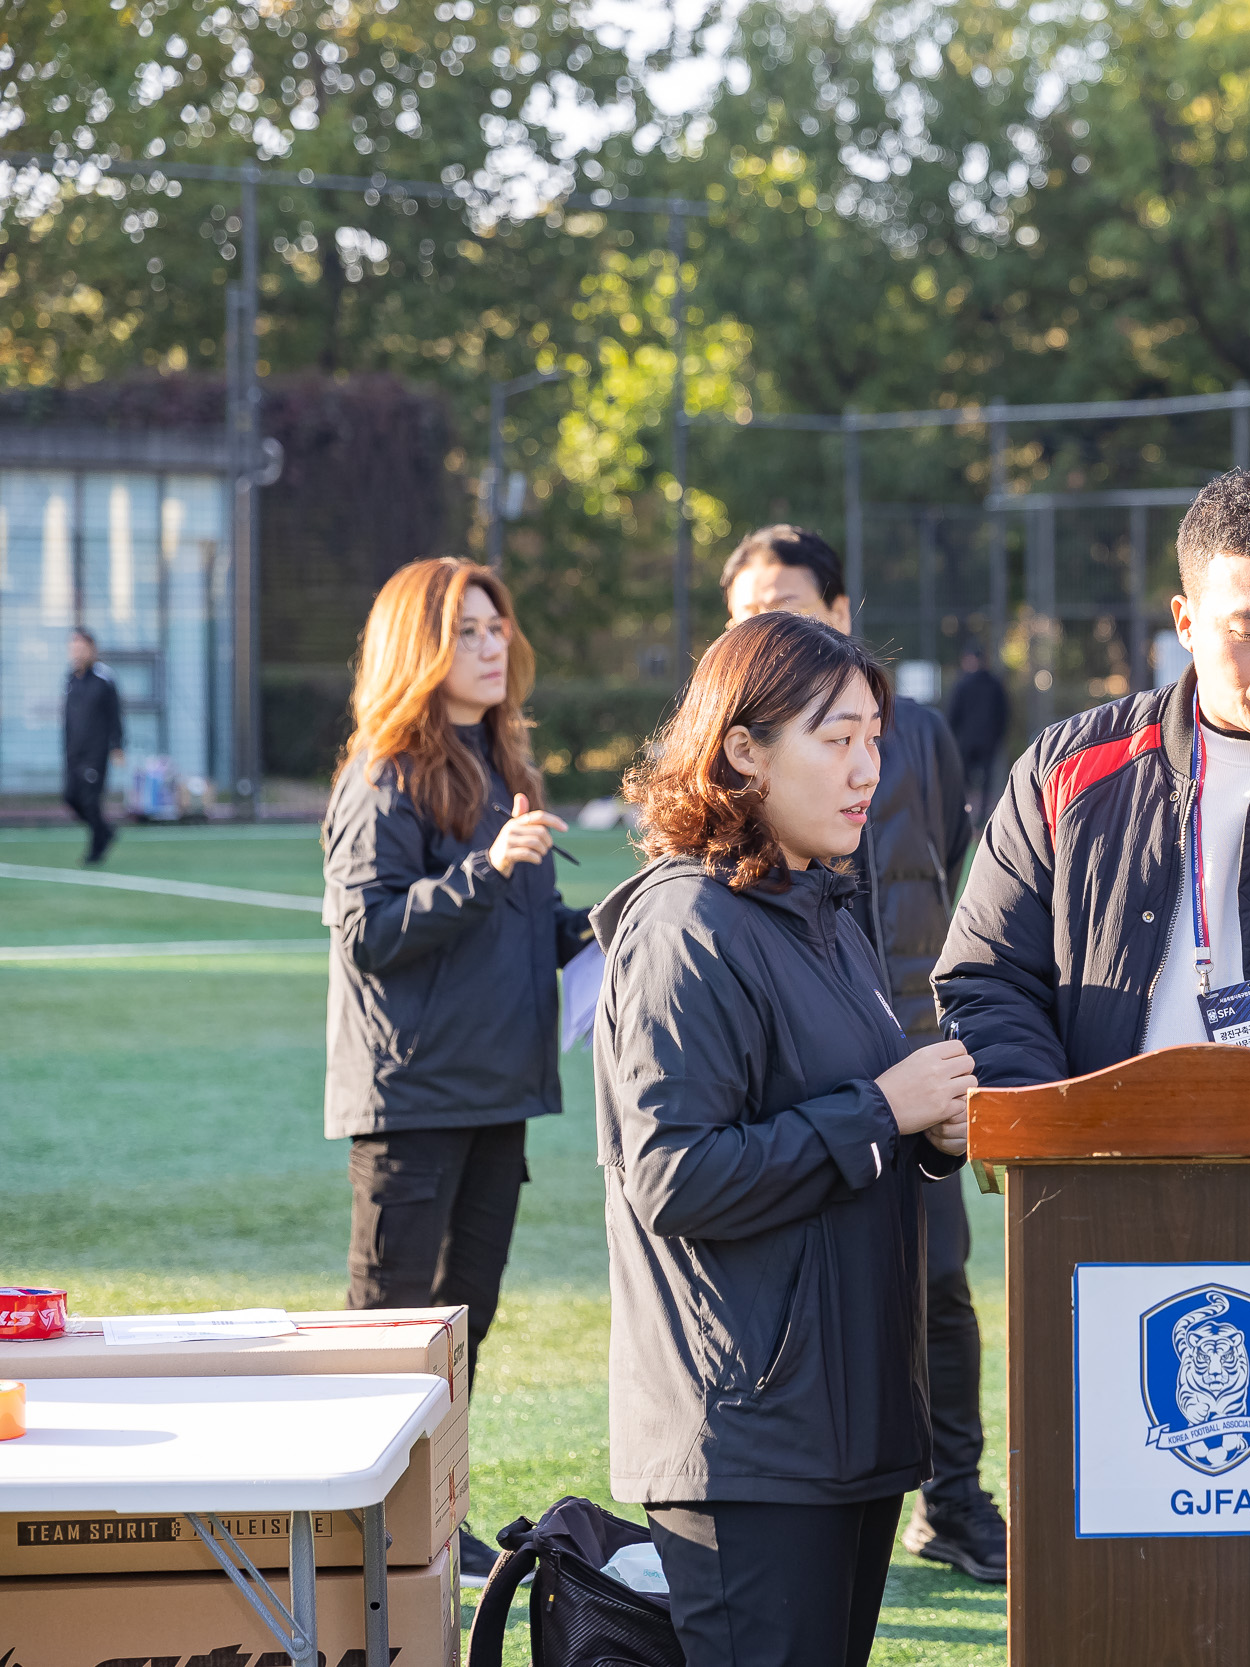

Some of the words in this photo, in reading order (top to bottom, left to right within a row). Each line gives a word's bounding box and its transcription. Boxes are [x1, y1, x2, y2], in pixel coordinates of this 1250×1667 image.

[1217, 1006, 1236, 1019] SFA
[1168, 1433, 1189, 1444] KOREA
[1190, 1424, 1220, 1437] FOOTBALL
[27, 1524, 80, 1542] TEAM
[89, 1522, 158, 1540] SPIRIT
[171, 1521, 182, 1537] &
[193, 1517, 324, 1537] THLEISE
